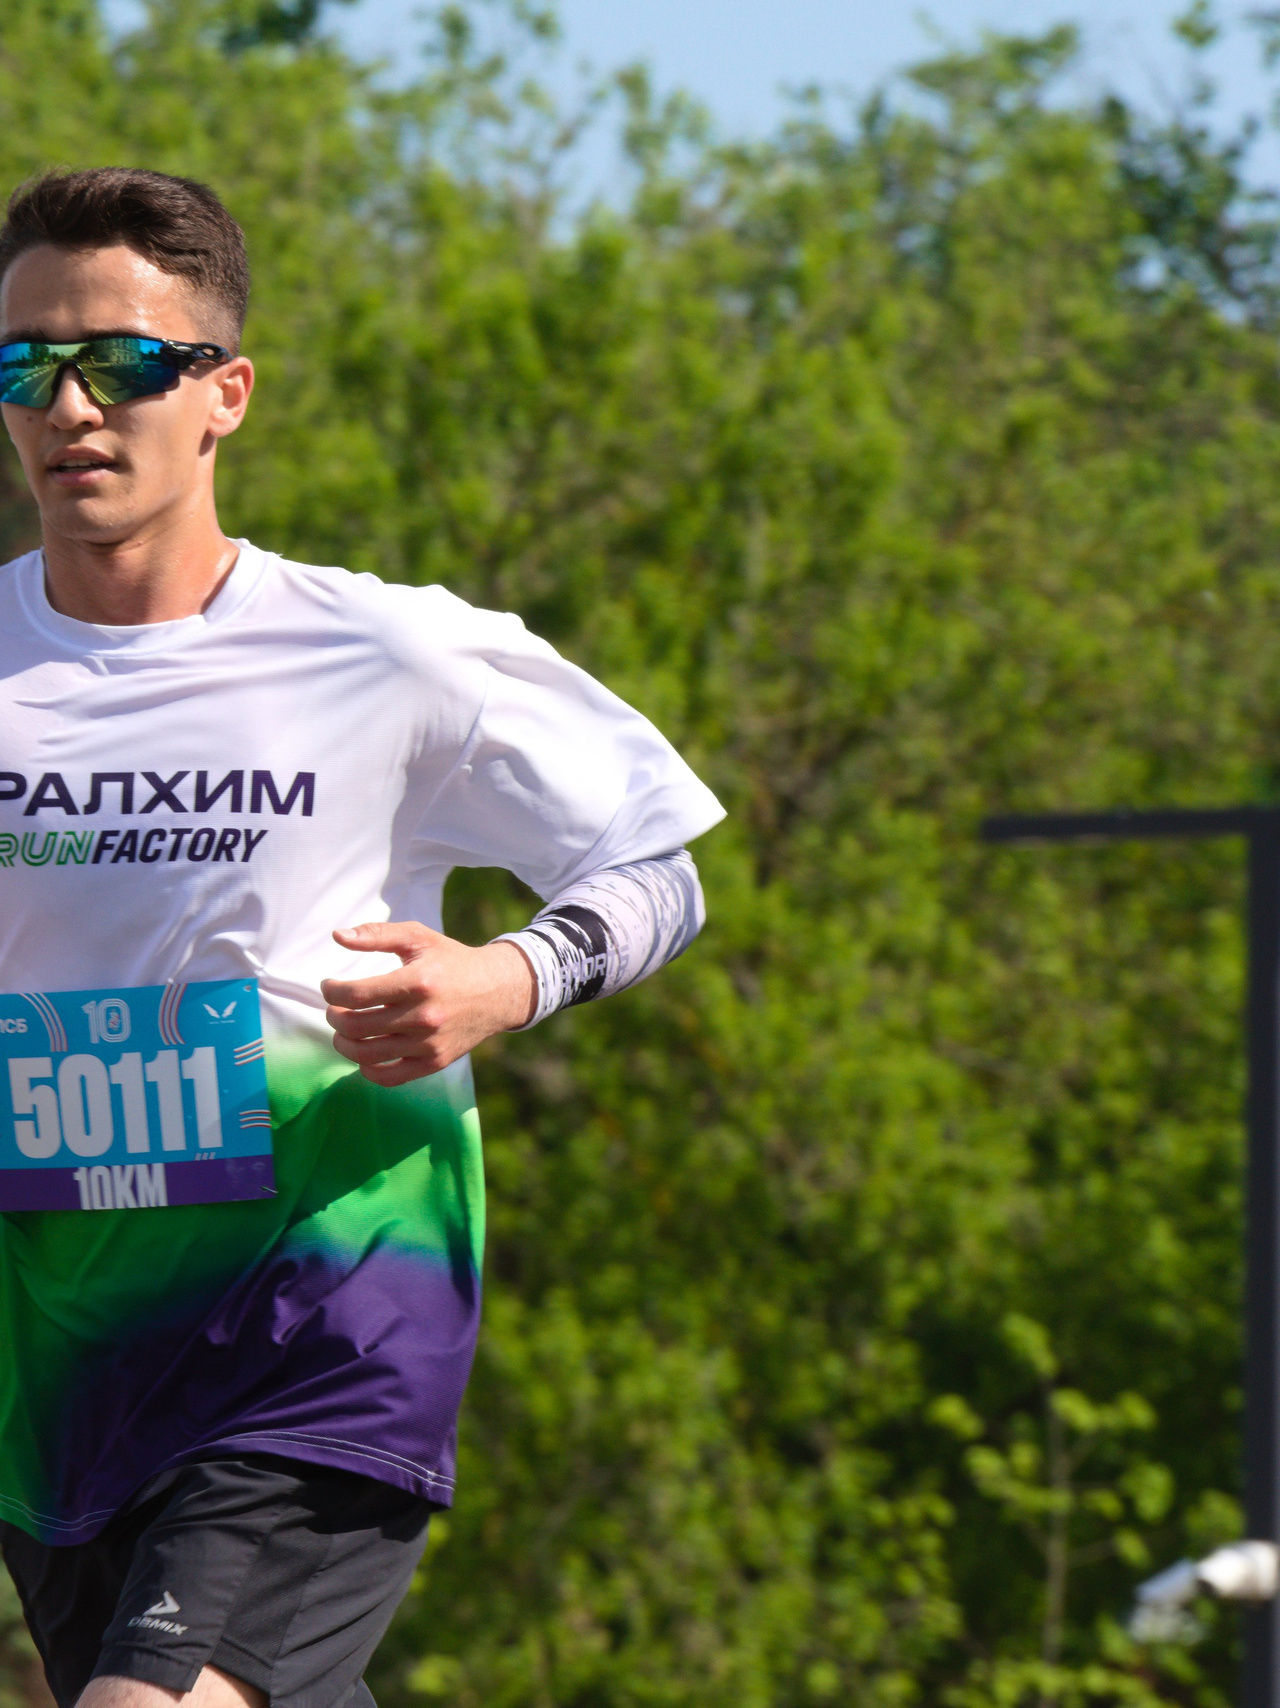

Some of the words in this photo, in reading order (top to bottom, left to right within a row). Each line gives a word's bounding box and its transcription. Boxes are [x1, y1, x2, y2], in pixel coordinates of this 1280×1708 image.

[80, 998, 132, 1044] 10
[7, 1045, 224, 1159] 50111
[73, 1162, 169, 1211] 10KM
[127, 1616, 189, 1636] DEMIX
